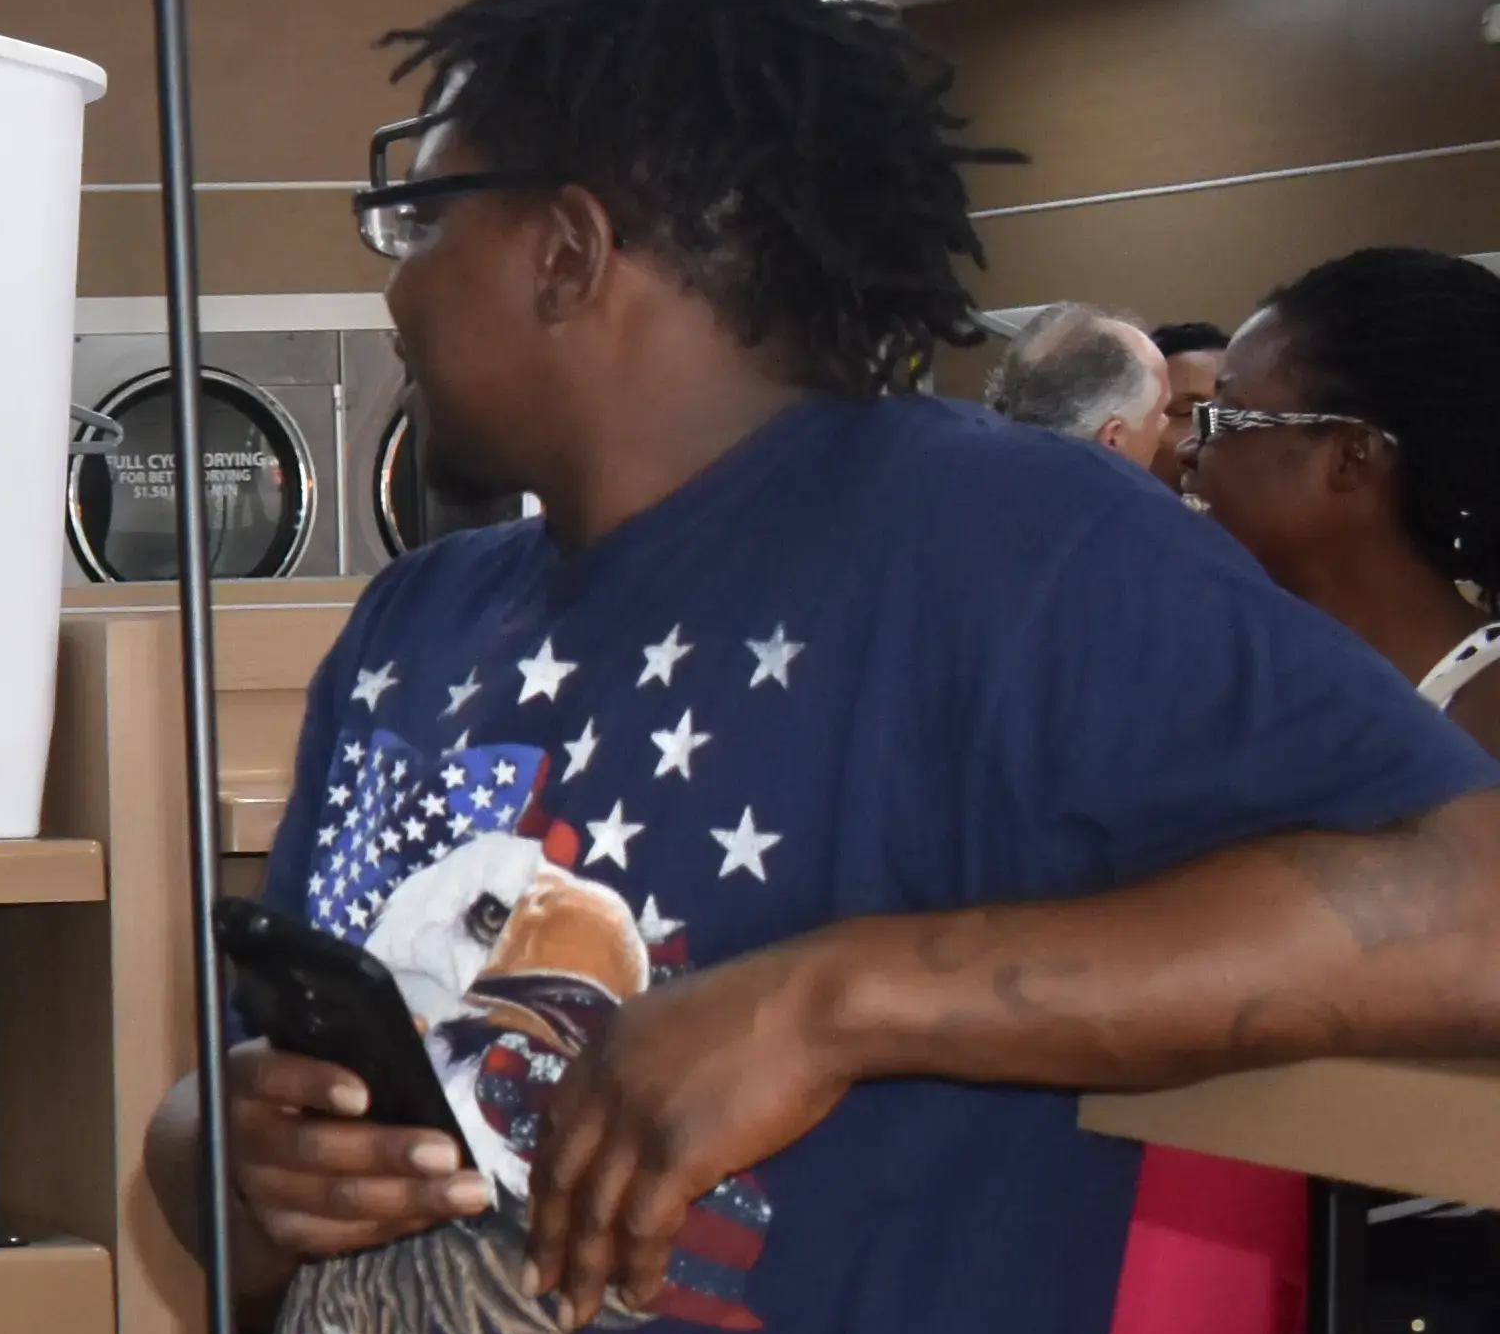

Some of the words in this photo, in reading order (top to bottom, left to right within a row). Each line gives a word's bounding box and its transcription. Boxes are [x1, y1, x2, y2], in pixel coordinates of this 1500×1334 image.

[106, 453, 145, 469] FULL
[148, 454, 176, 469] CYC
[204, 451, 265, 467] DRYING
[119, 470, 146, 484] FOR
[149, 470, 176, 484] BET
